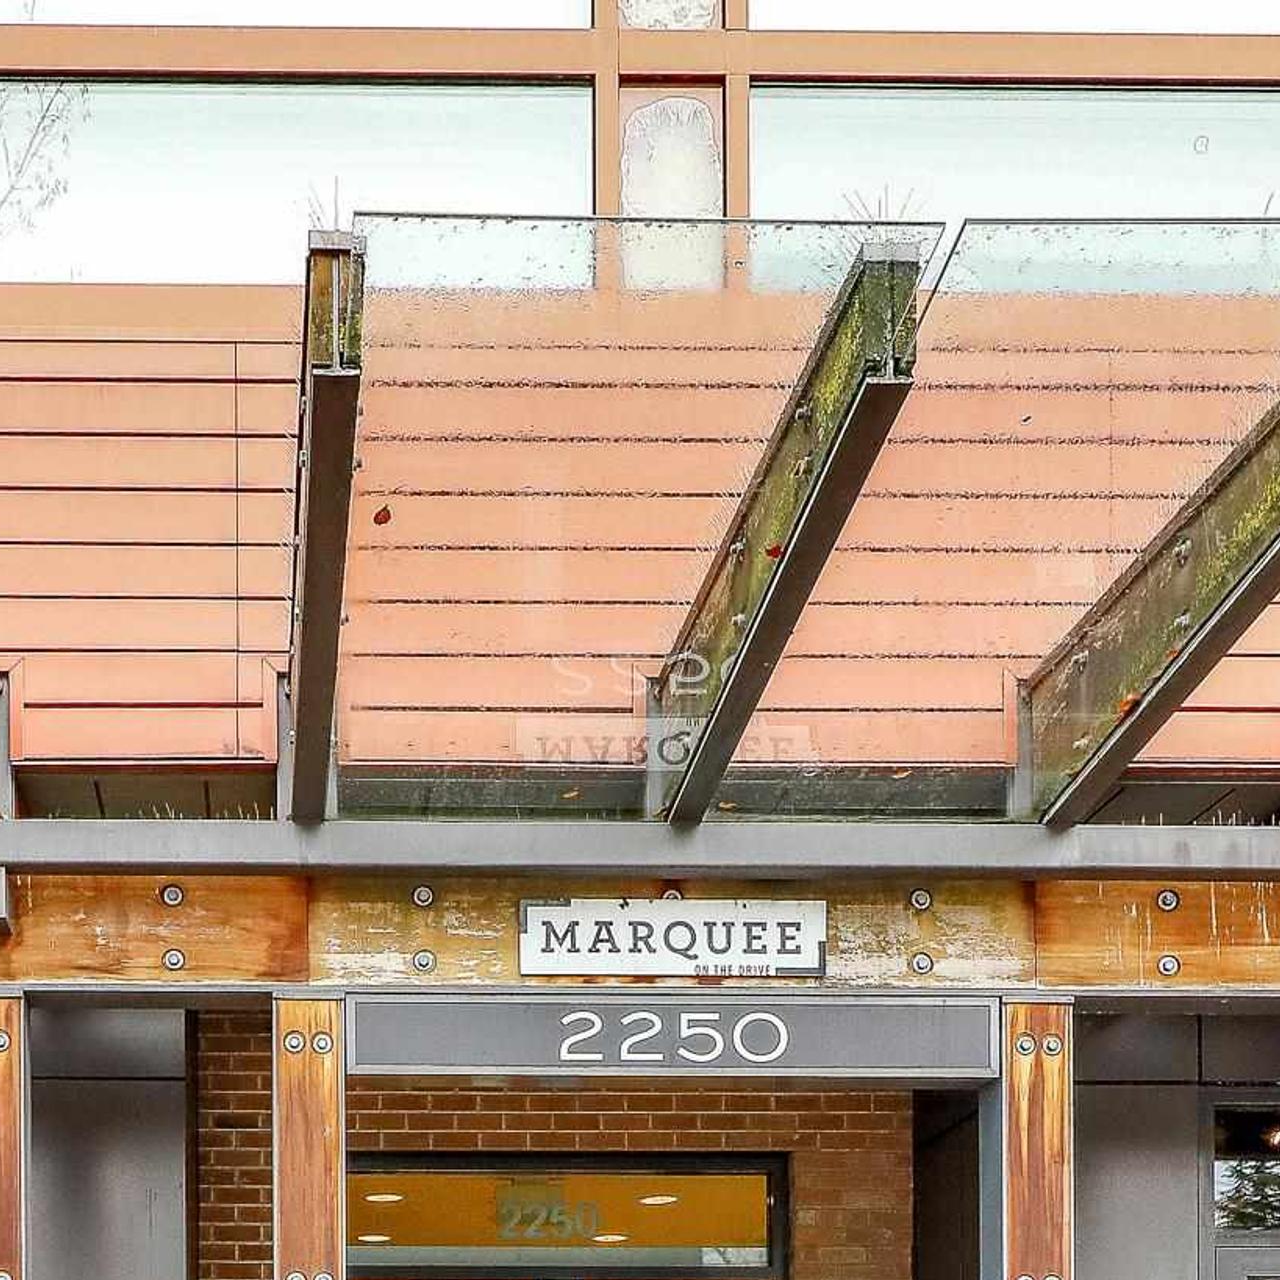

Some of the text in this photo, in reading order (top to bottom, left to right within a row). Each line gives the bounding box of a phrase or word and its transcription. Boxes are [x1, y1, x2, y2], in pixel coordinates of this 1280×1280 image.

[540, 920, 802, 960] MARQUEE
[694, 964, 771, 976] ON THE DRIVE
[559, 1011, 789, 1062] 2250
